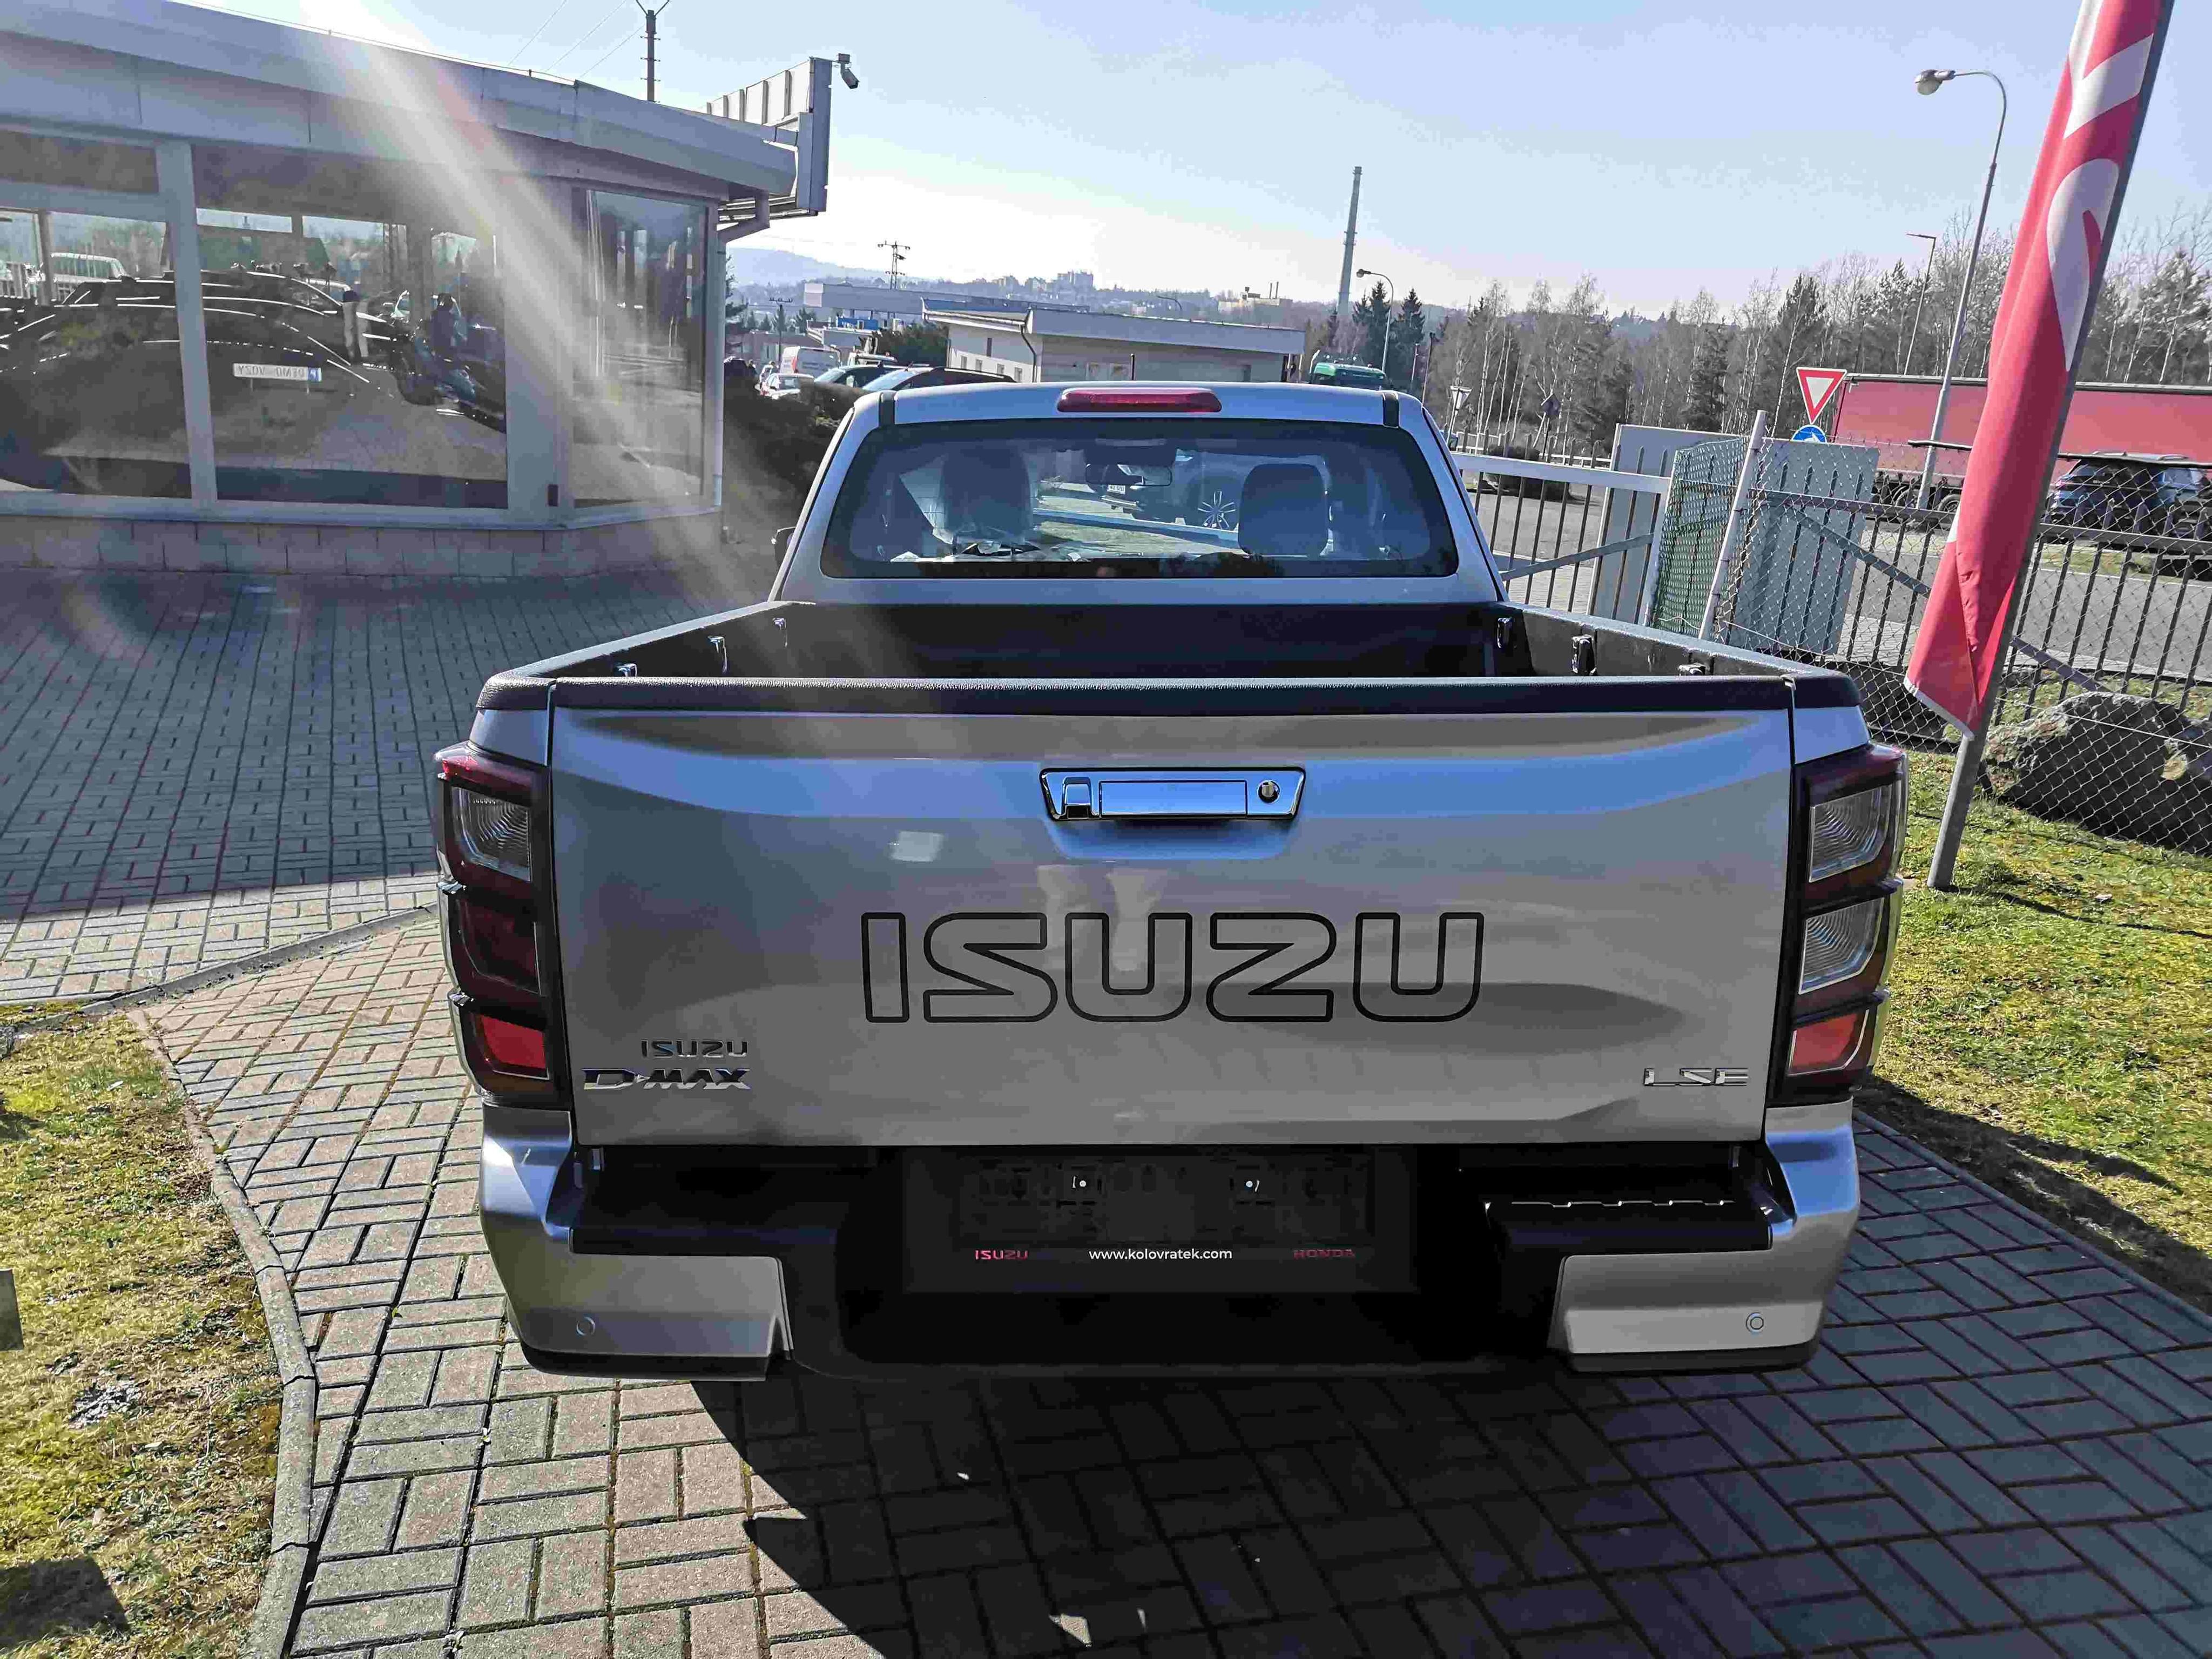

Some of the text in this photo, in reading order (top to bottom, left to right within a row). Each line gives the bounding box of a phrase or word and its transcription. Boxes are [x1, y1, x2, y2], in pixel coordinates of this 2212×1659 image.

[861, 913, 1484, 1023] ISUZU
[640, 1038, 750, 1058] ISUZU
[582, 1067, 751, 1090] D-MAX
[1643, 1067, 1749, 1087] LSE
[975, 1249, 1029, 1260] ISUZU
[1088, 1248, 1233, 1260] www.kolovratek.com
[1293, 1249, 1356, 1259] HONDA
